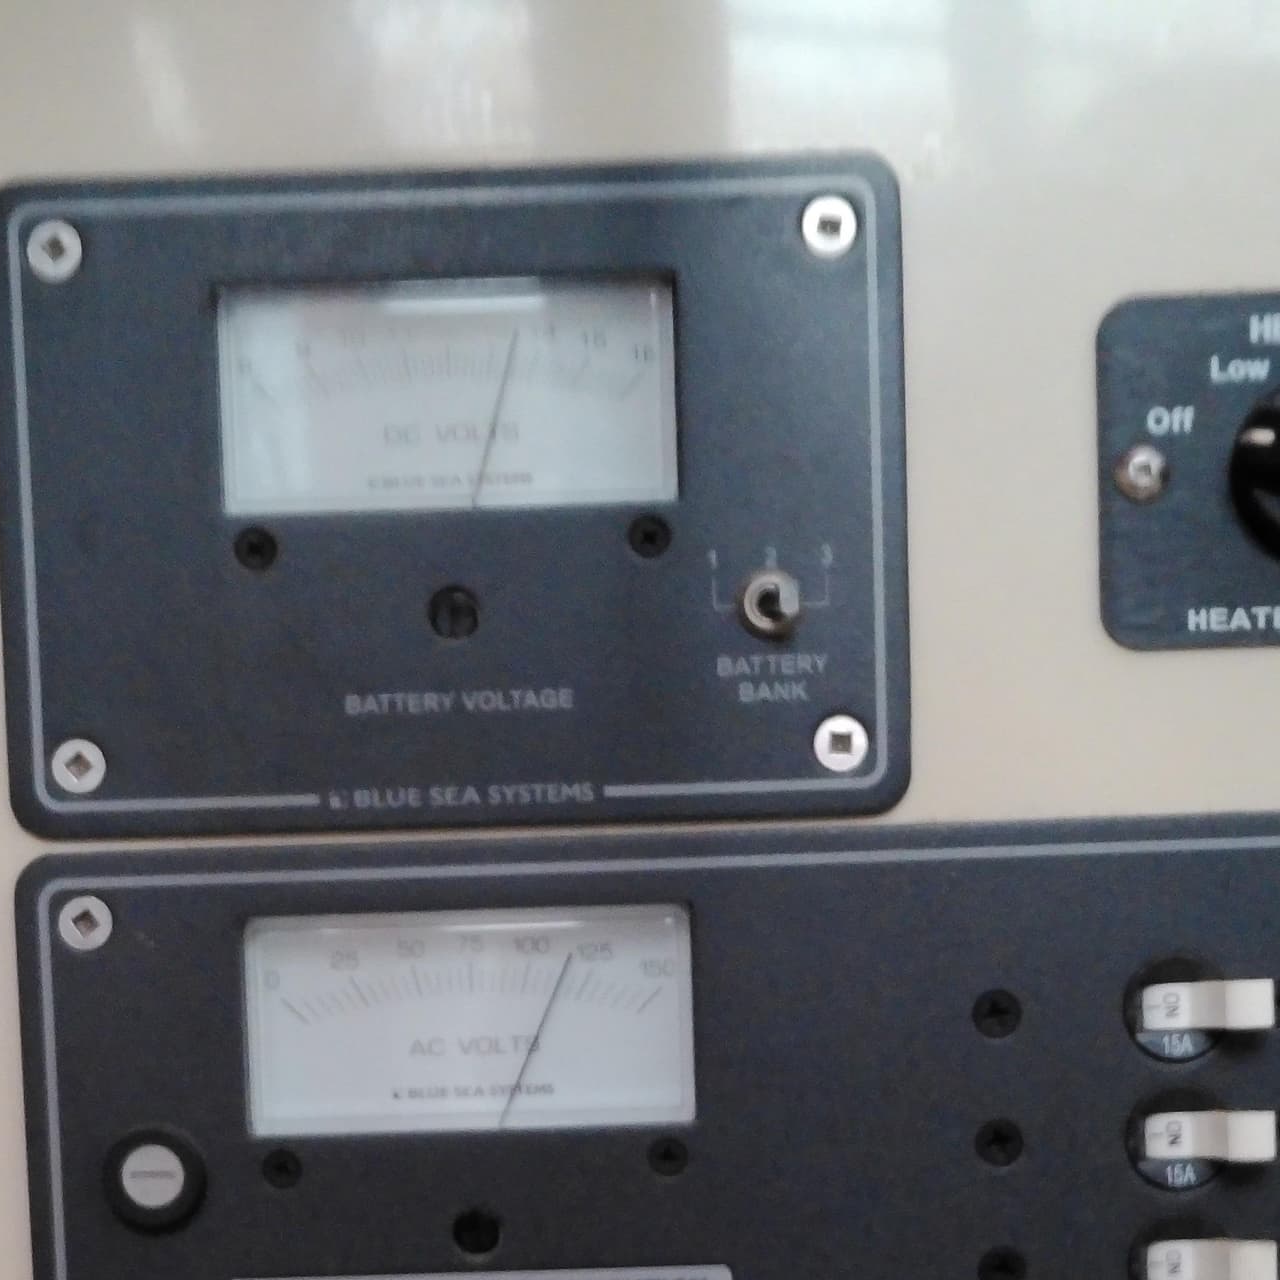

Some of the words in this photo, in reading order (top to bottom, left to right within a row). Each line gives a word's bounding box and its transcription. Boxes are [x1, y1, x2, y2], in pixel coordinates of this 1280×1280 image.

[1209, 354, 1270, 383] Low
[1146, 404, 1195, 437] Off
[716, 653, 829, 677] BATTERY
[344, 691, 454, 715] BATTERY
[460, 687, 574, 713] VOLTAGE
[738, 680, 809, 702] BANK
[352, 787, 422, 809] BLUE
[428, 784, 481, 806] SEA
[487, 782, 595, 806] SYSTEMS
[395, 938, 427, 961] 50
[457, 934, 487, 955] 75
[512, 934, 551, 956] 100
[329, 949, 361, 972] 25
[408, 1037, 446, 1057] AC
[457, 1034, 540, 1056] VOLTS
[1161, 1034, 1194, 1057] 15A
[1165, 1163, 1197, 1187] 15A
